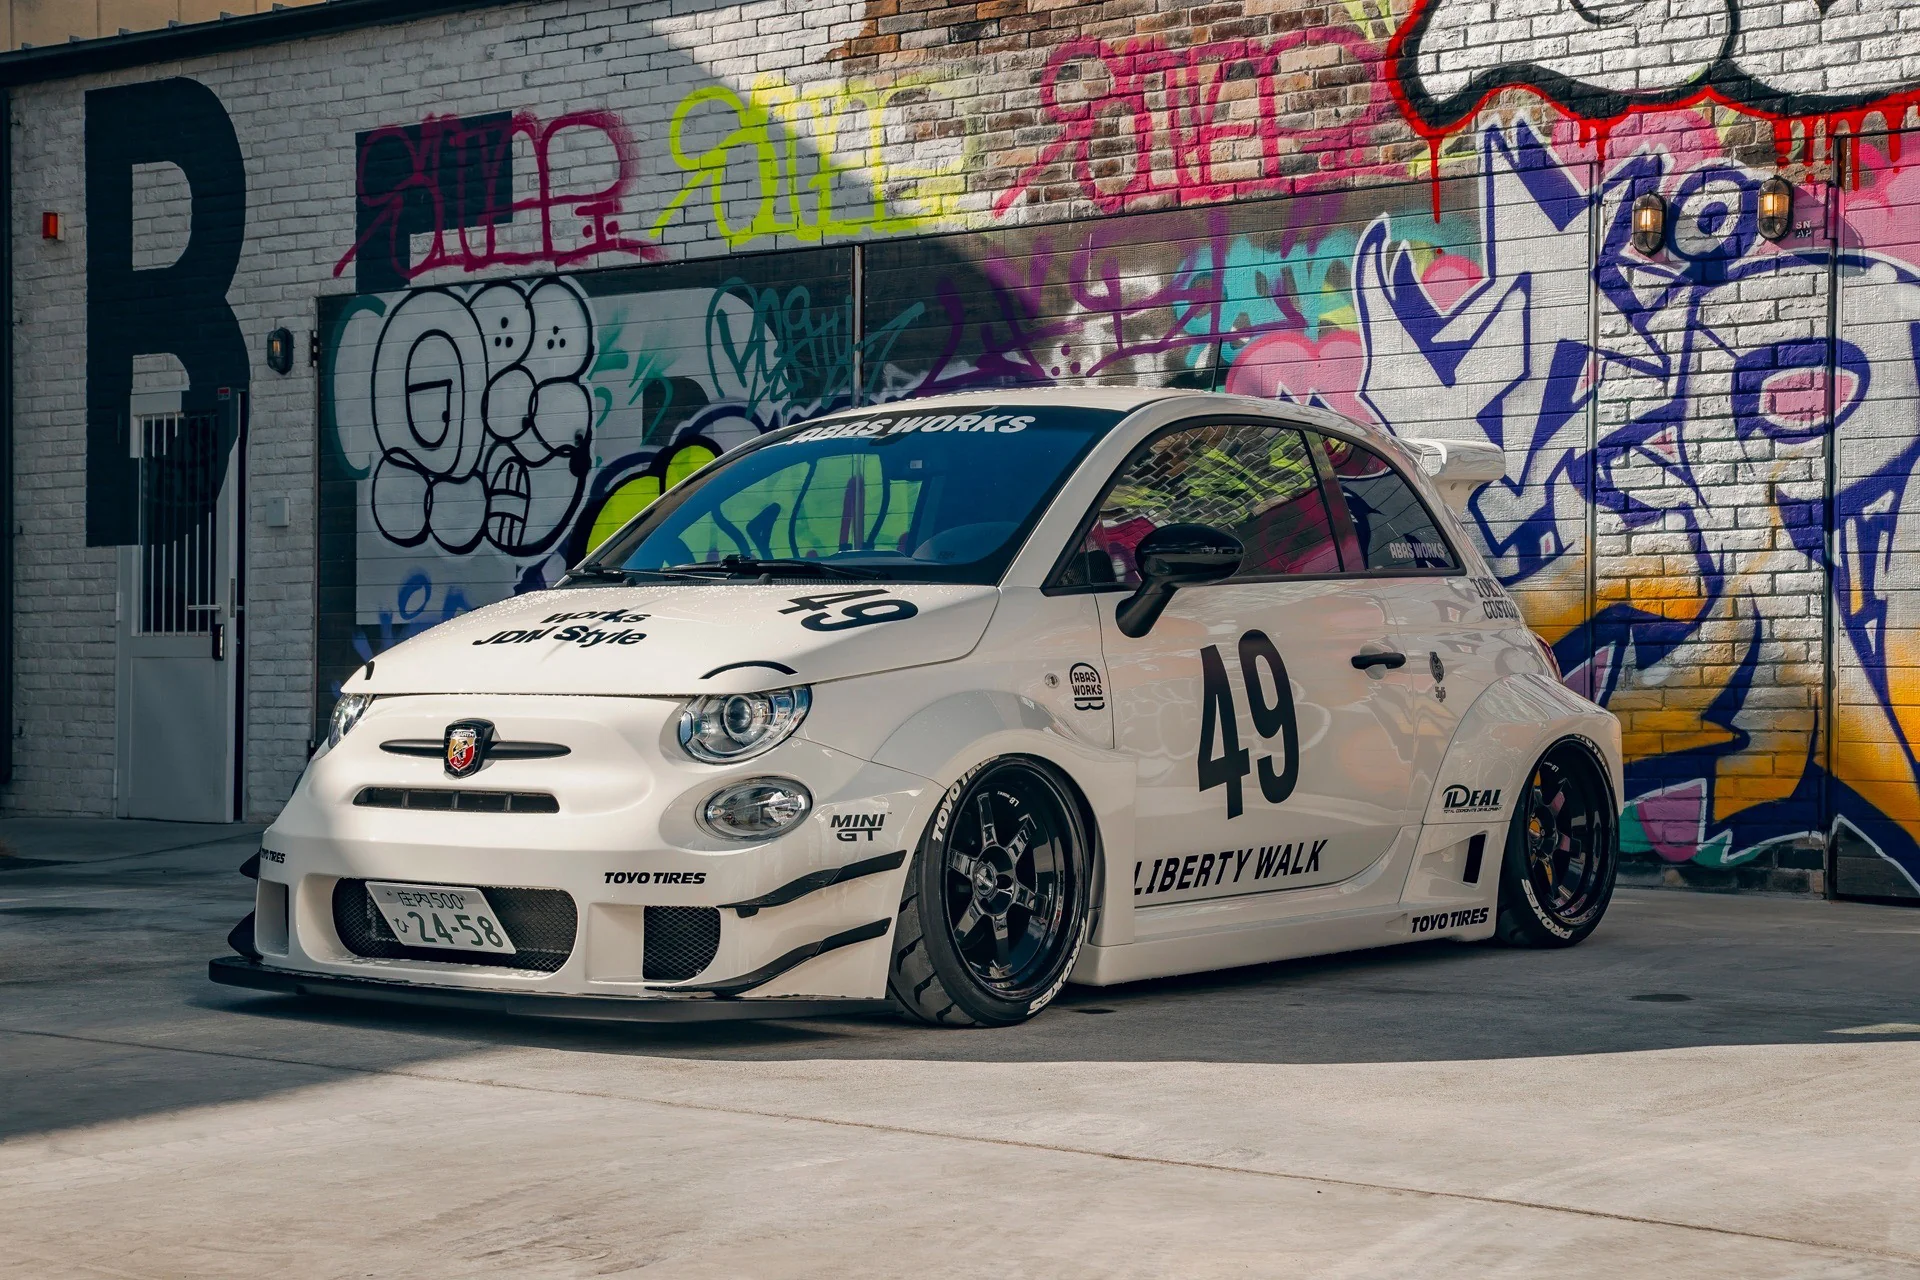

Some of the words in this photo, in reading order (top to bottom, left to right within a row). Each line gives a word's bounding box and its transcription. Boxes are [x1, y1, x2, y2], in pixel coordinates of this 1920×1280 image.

[786, 418, 892, 445] ABAS
[888, 415, 1036, 434] WORKS
[1389, 543, 1414, 559] ABAS
[1414, 542, 1445, 559] WORKS
[777, 589, 919, 632] 49
[553, 625, 648, 648] Style
[1072, 684, 1103, 696] WORKS
[1073, 672, 1096, 683] ABAS
[1197, 629, 1299, 820] 49
[1442, 784, 1501, 808] IDEAL
[830, 814, 885, 827] MINI
[932, 781, 961, 842] TOYO
[837, 828, 882, 842] GT
[604, 872, 650, 884] TOYO
[653, 872, 707, 884] TIRES
[1134, 848, 1253, 896] LIBERTY
[1254, 839, 1329, 880] WALK
[1412, 913, 1448, 933] TOYO
[1450, 907, 1489, 928] TIRES
[1521, 879, 1573, 939] PROXES
[407, 911, 504, 948] 24-58
